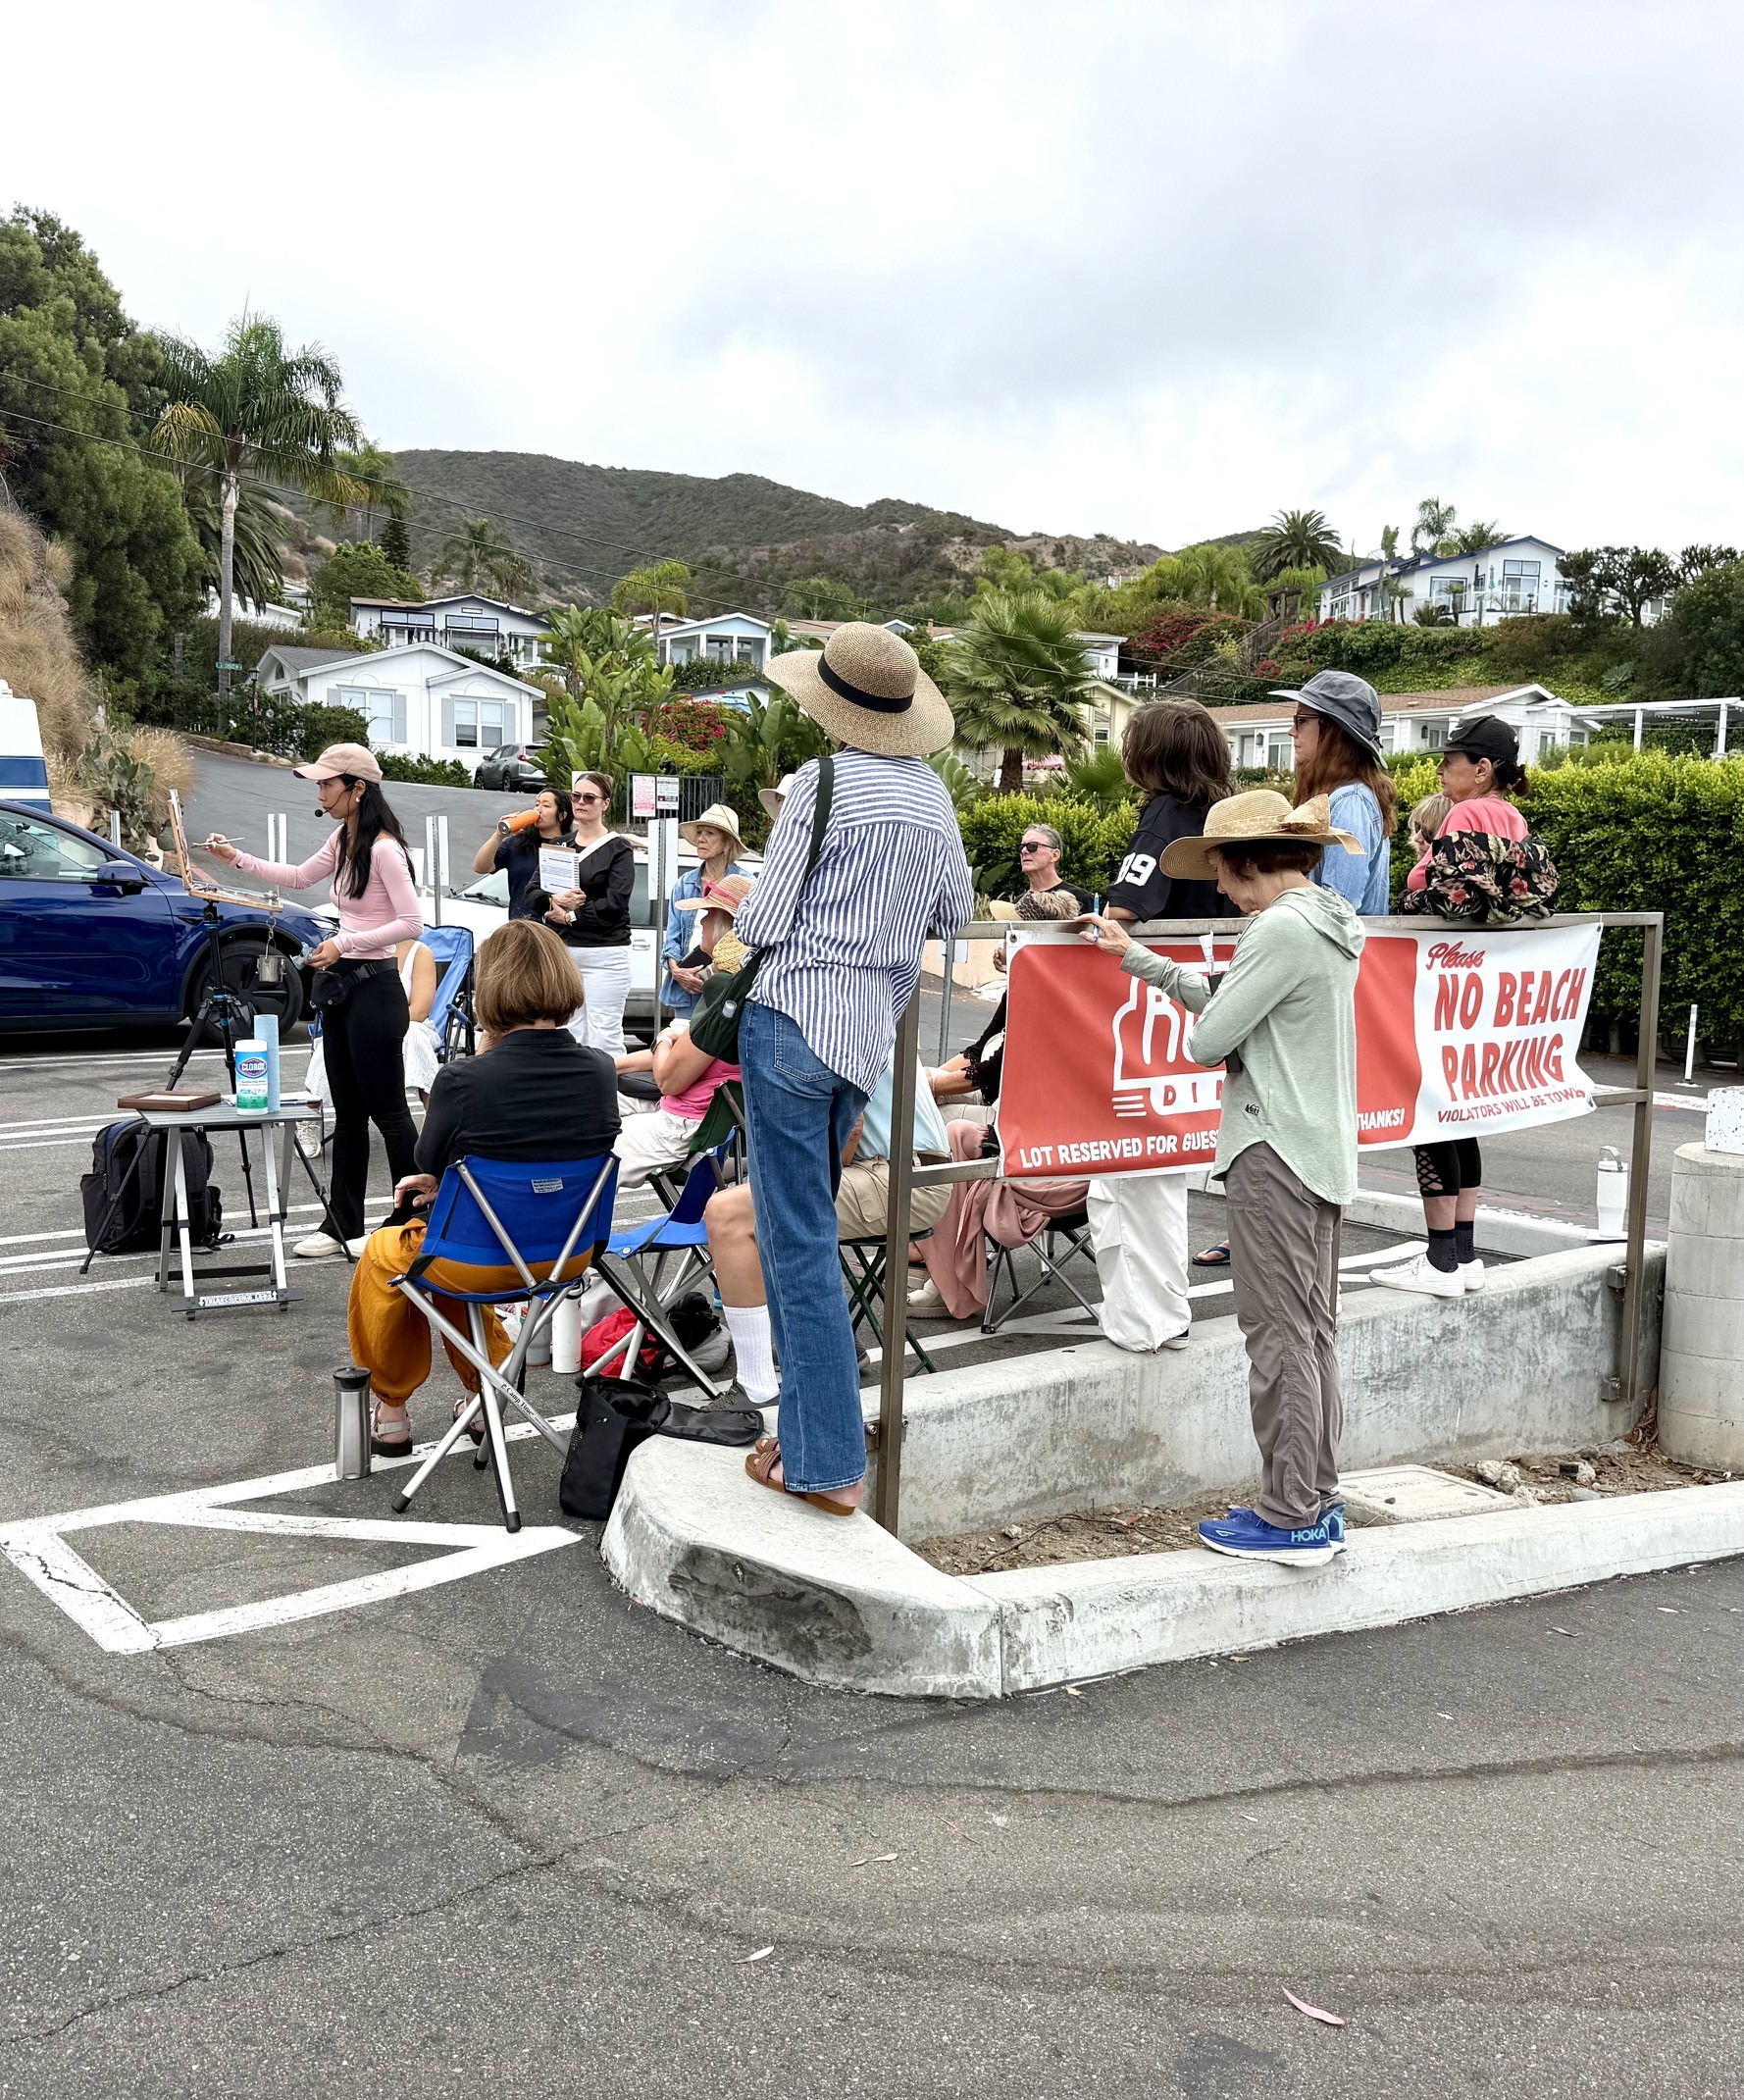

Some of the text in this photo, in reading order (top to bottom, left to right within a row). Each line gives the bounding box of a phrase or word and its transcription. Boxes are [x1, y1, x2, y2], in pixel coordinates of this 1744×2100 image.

[1426, 942, 1486, 970] Please
[1434, 967, 1587, 1031] NO BEACH
[1441, 1033, 1564, 1102] PARKING
[1438, 1102, 1502, 1123] VIOLATORS
[1501, 1099, 1530, 1113] WILL
[1530, 1094, 1547, 1107] BE
[1019, 1129, 1219, 1168] LOT RESERVED FOR GUES
[1291, 1527, 1326, 1543] HOKA
